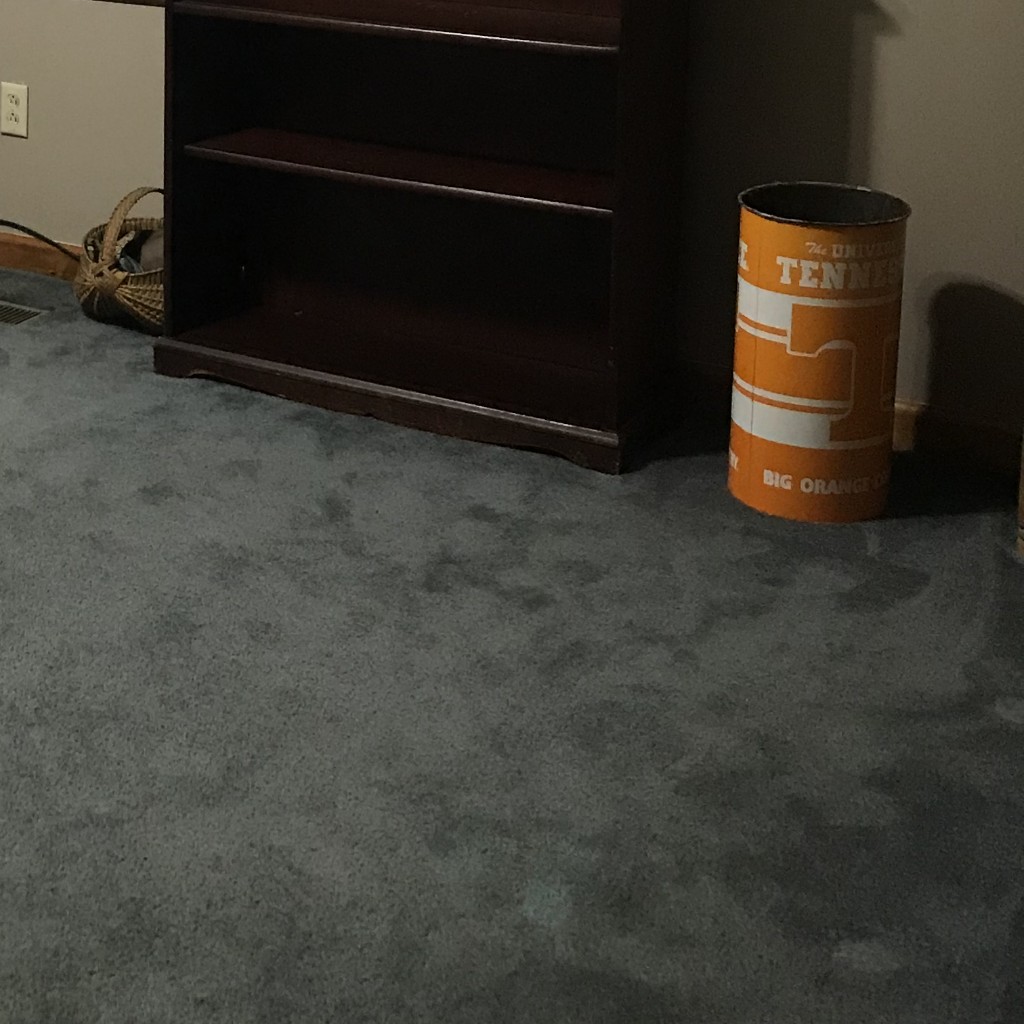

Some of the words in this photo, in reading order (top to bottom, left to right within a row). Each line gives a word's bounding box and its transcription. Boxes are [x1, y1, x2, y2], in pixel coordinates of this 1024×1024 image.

[804, 241, 828, 256] The
[763, 469, 793, 490] BIG
[800, 476, 870, 495] ORANGE
